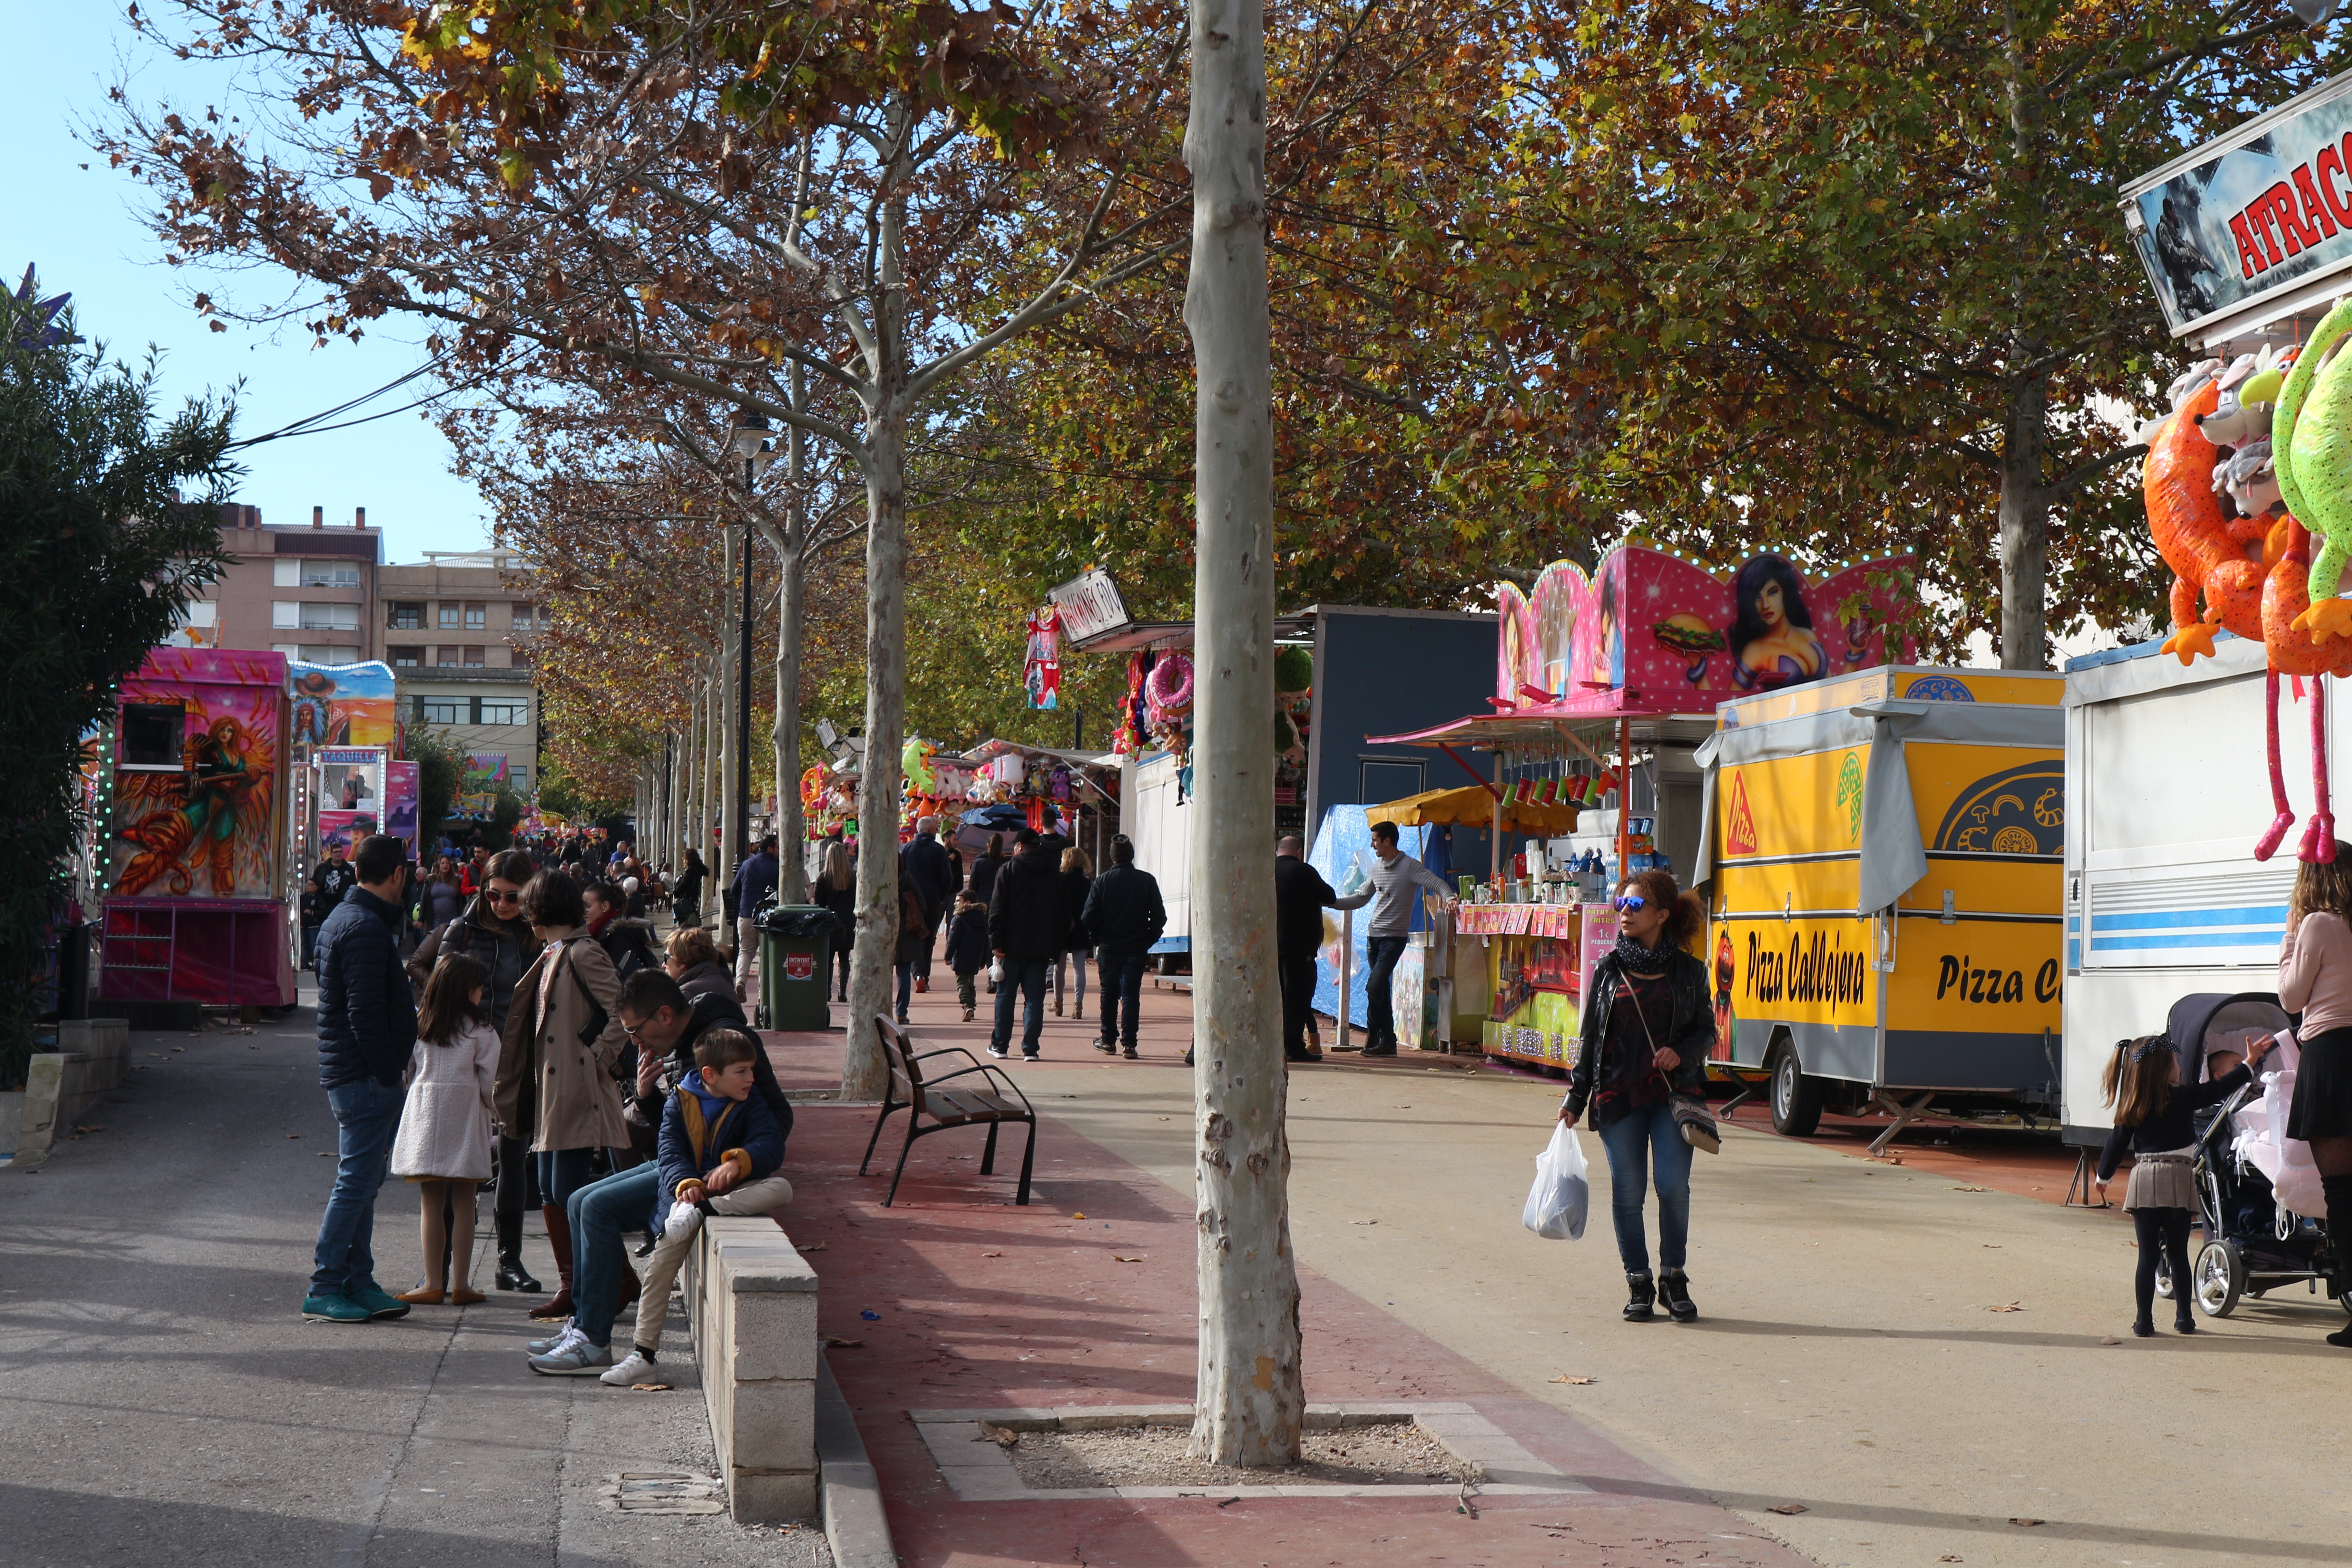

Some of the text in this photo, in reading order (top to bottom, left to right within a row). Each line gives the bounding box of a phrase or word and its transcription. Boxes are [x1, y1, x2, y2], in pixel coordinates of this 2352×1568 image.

[1176, 695, 1192, 708] donut
[322, 751, 377, 762] TAQUILLA
[1729, 780, 1754, 848] Pizza
[1746, 930, 1864, 1019] Pizza Callejera
[1937, 955, 2023, 1004] Pizza
